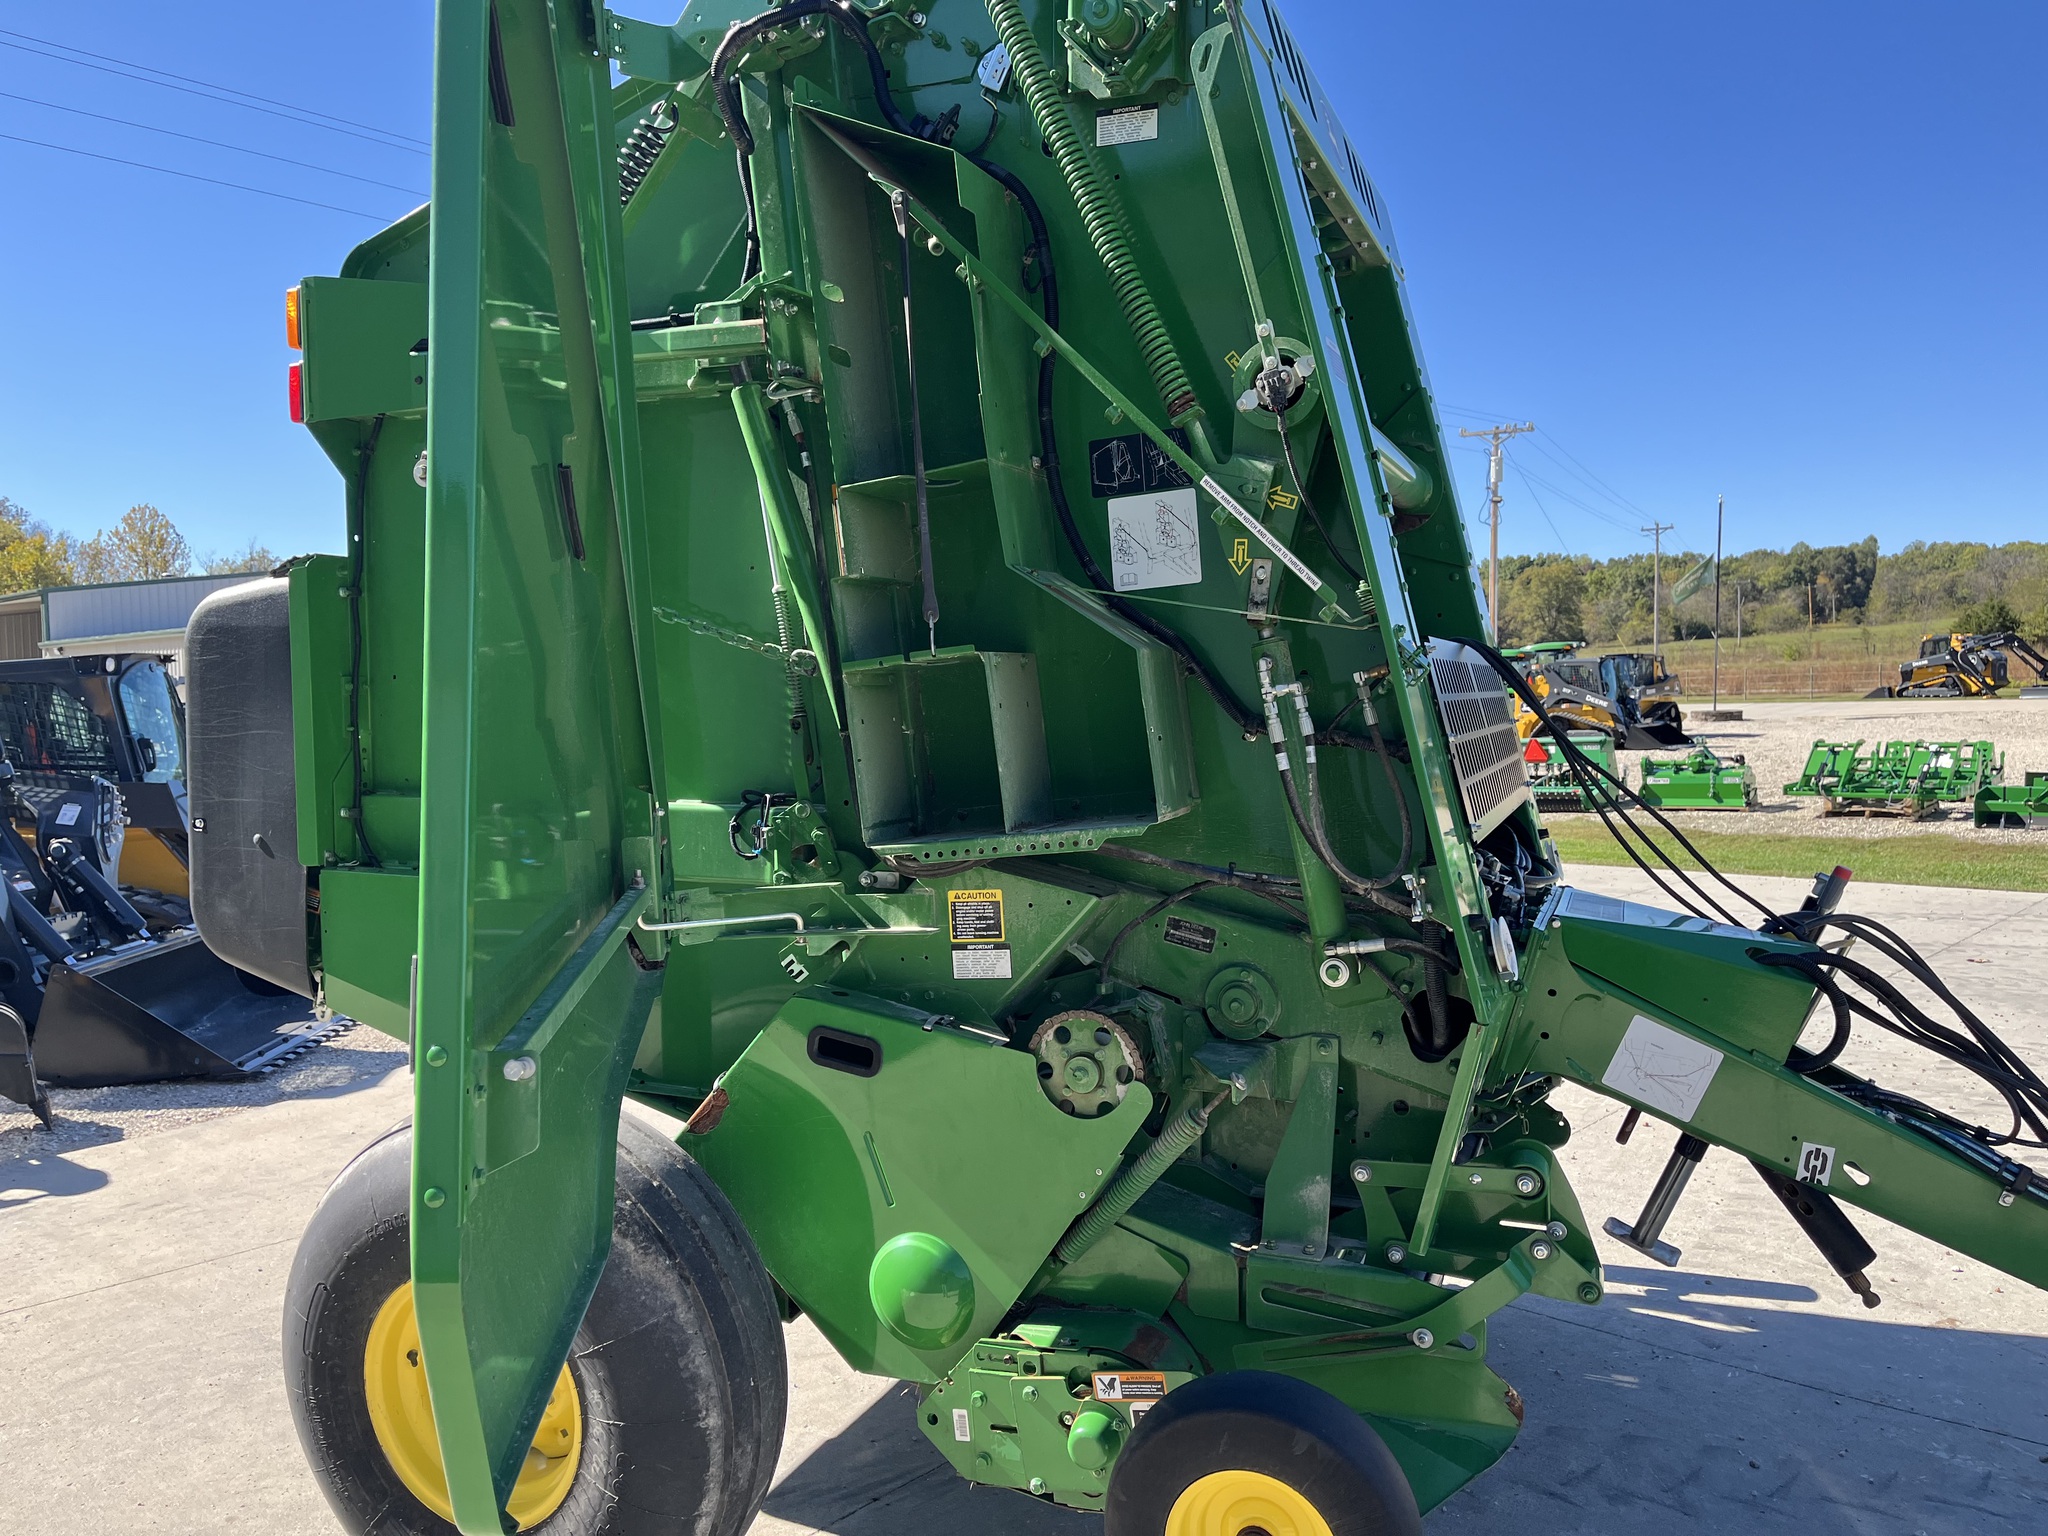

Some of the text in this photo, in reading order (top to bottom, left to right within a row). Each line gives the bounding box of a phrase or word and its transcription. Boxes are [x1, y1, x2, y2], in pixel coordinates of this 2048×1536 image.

[1112, 105, 1142, 114] IMPORTANT
[1203, 478, 1221, 497] REMOVE
[1220, 494, 1231, 506] ARM
[1229, 501, 1243, 517] FROM
[1242, 514, 1258, 531] NOTCH
[1256, 528, 1267, 539] AND
[1265, 536, 1282, 554] LOWER
[1286, 556, 1305, 575] THREAD
[1303, 571, 1319, 588] TWINE
[1585, 694, 1608, 707] DEERE
[961, 892, 997, 900] CAUTION
